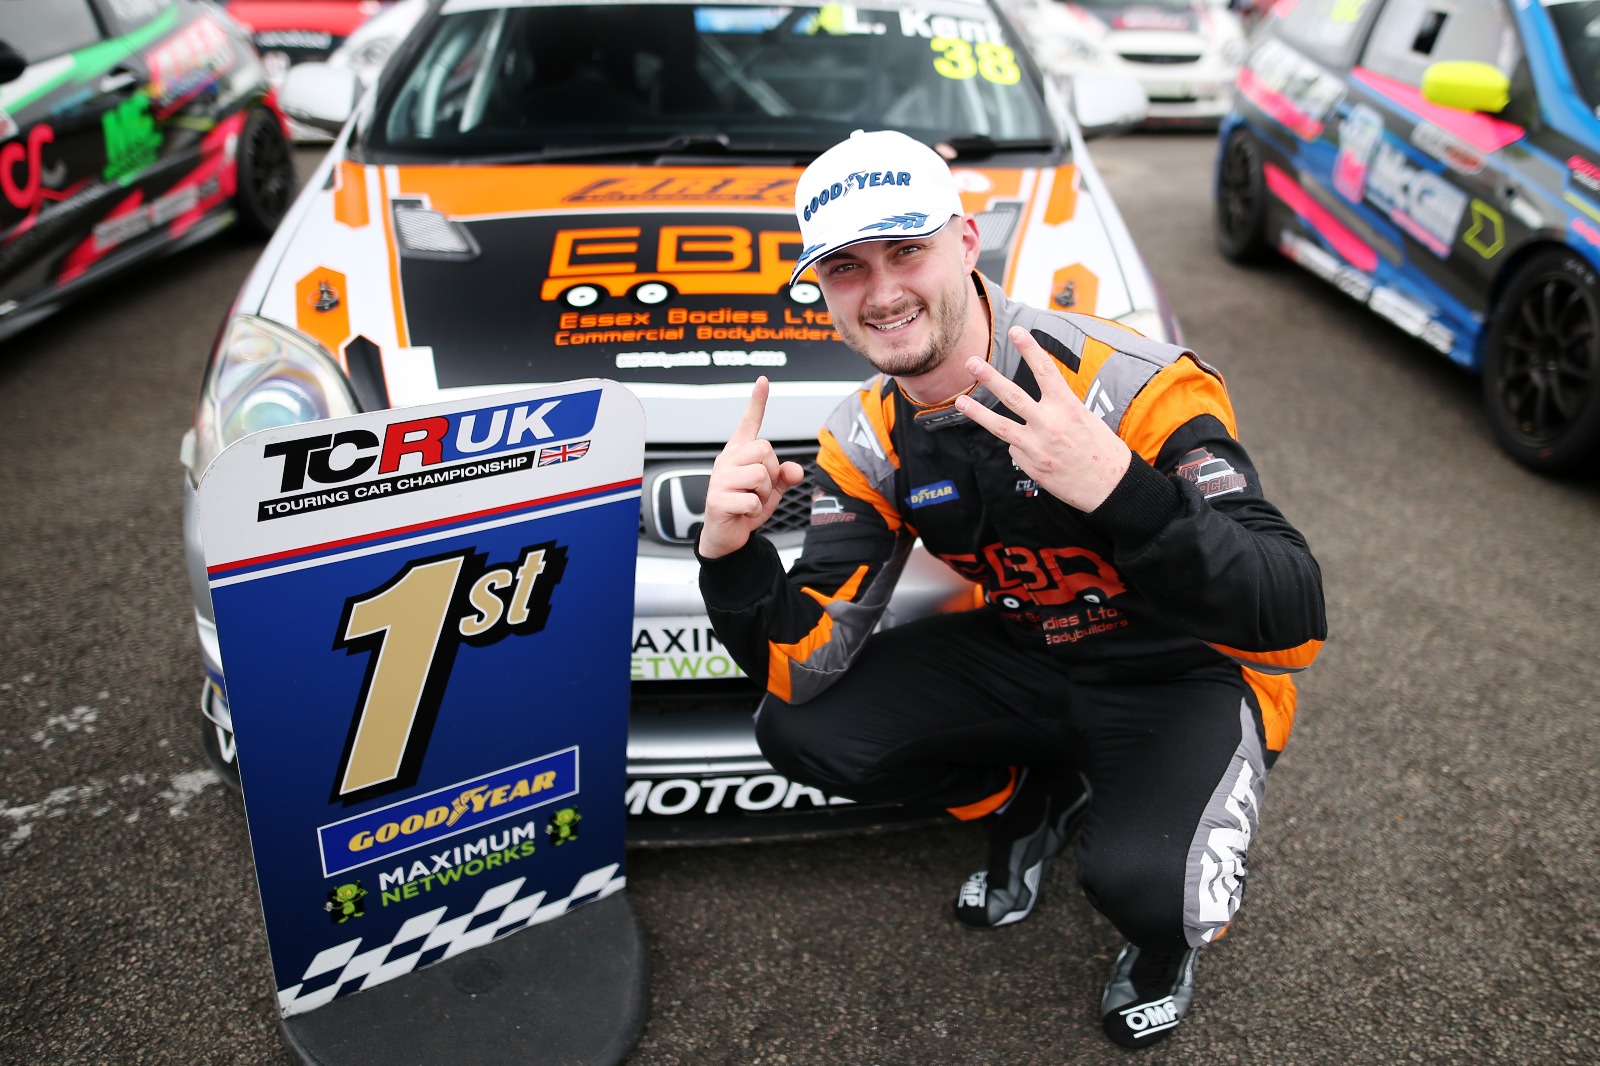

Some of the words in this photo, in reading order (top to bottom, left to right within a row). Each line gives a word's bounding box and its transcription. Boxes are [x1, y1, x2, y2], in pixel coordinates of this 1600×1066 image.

[930, 36, 1021, 86] 38
[803, 171, 912, 221] GOODYEAR
[554, 327, 684, 346] Commercial
[696, 325, 844, 343] Bodybuilders
[558, 311, 651, 329] Essex
[667, 308, 768, 325] Bodies
[264, 490, 350, 515] TOURING
[354, 482, 392, 498] CAR
[396, 456, 528, 489] CHAMPIONSHIP
[911, 486, 952, 504] DYEAR
[338, 547, 548, 797] 1st
[348, 770, 557, 853] GOODYEAR
[379, 821, 536, 892] MAXIMUM
[382, 841, 536, 907] NETWORKS
[1126, 1001, 1178, 1030] OMP
